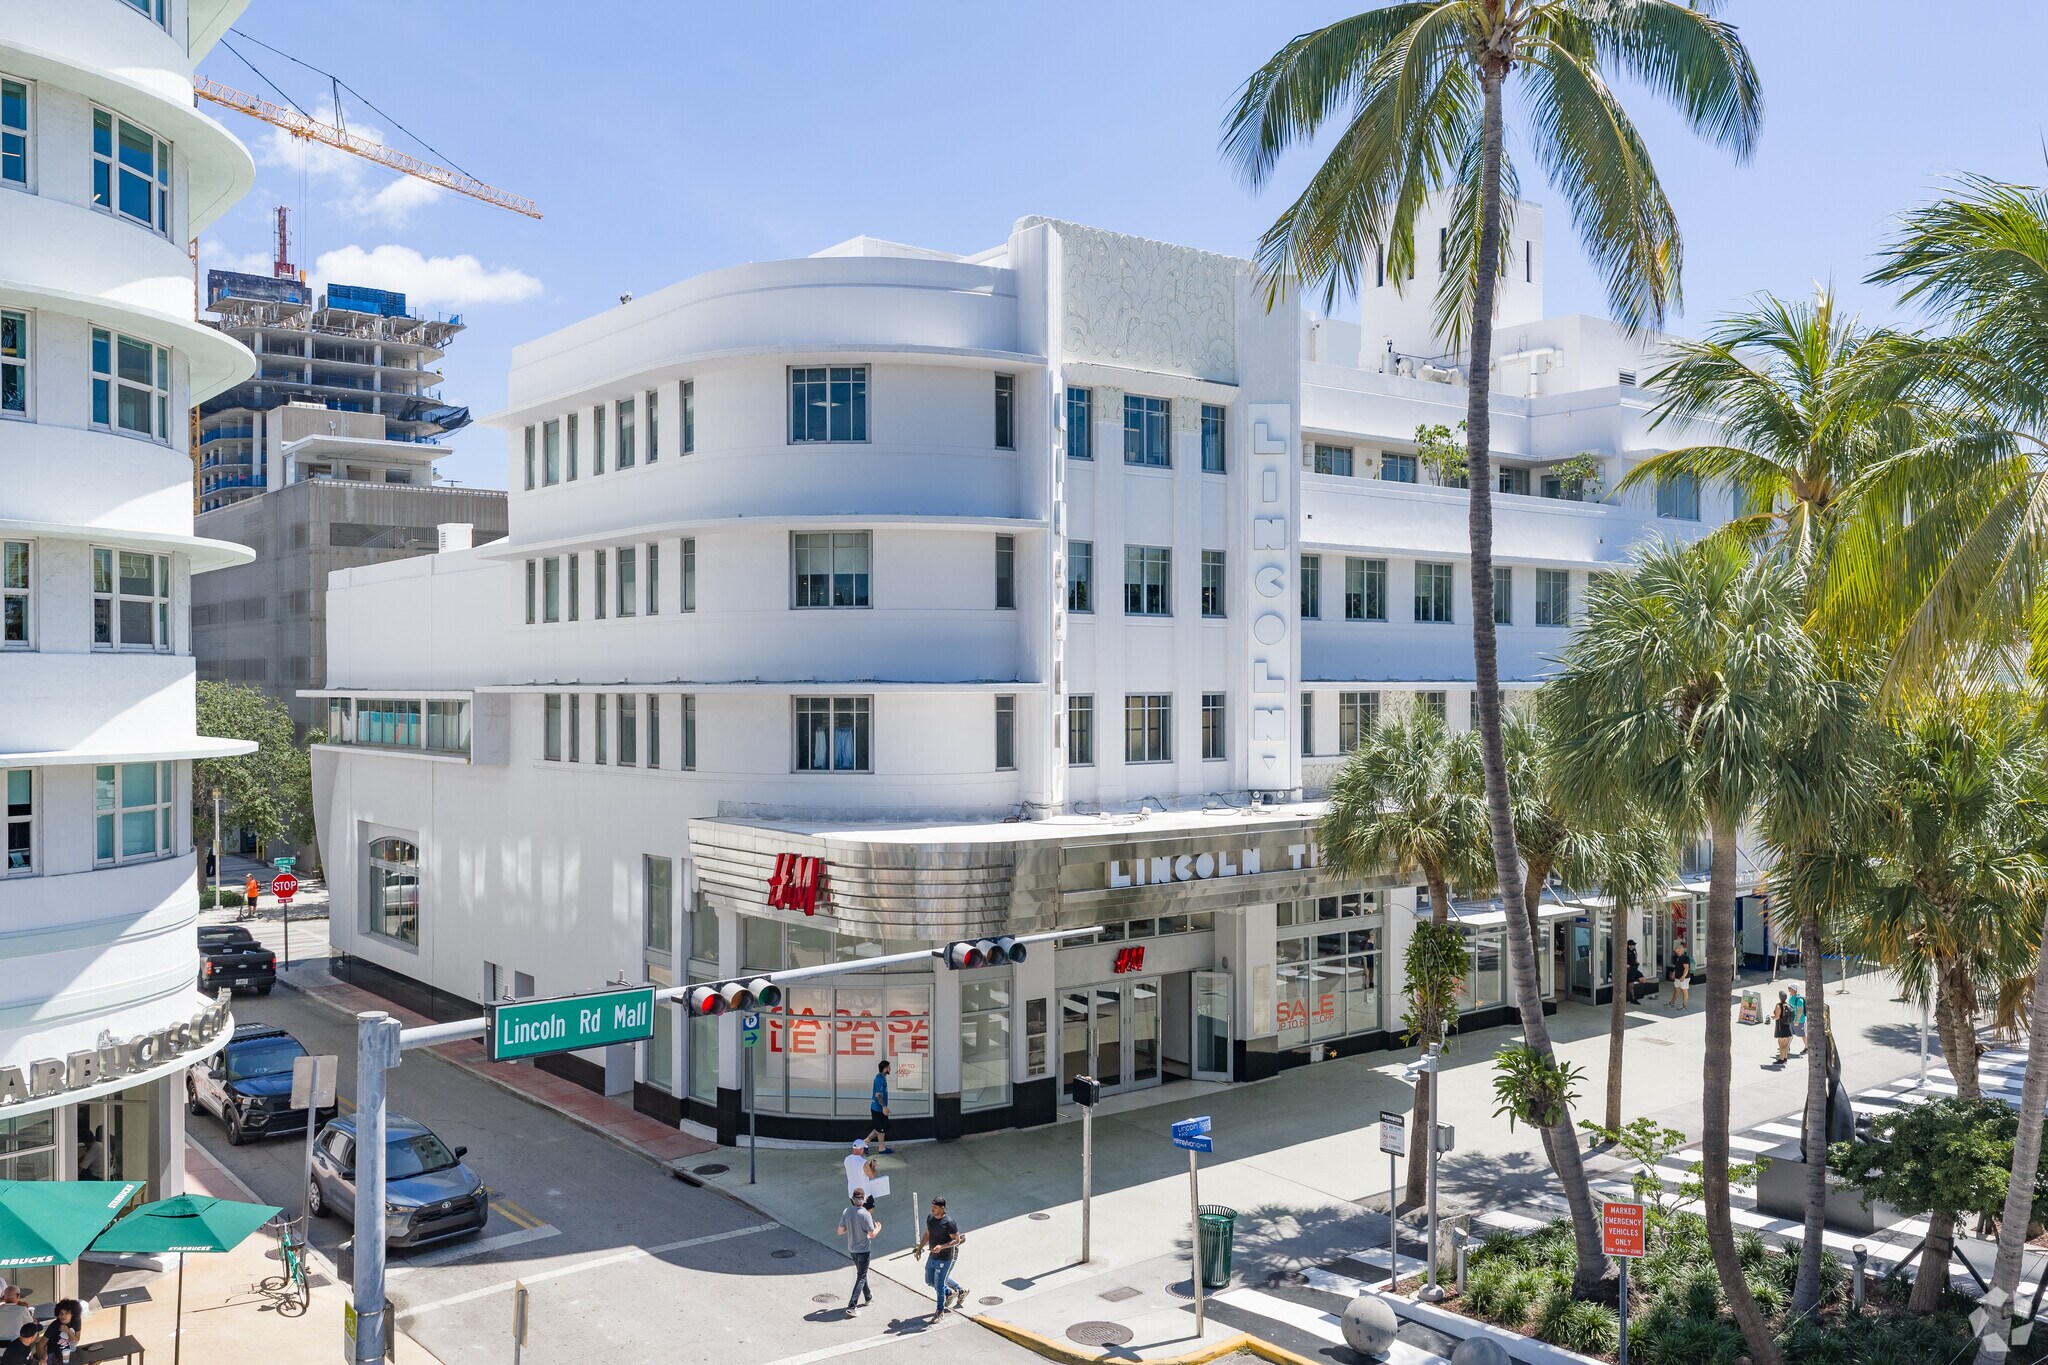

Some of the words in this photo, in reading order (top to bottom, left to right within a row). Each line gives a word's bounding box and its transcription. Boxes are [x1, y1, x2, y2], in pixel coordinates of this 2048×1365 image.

[1254, 422, 1286, 741] LINCOLN
[1108, 848, 1261, 888] LINCOLN
[273, 880, 297, 892] STOP
[1277, 994, 1334, 1023] SALE
[504, 1014, 565, 1045] Lincoln
[580, 1008, 600, 1034] Rd
[614, 1001, 646, 1029] Mall
[1610, 1207, 1636, 1215] MARKED
[1605, 1217, 1641, 1226] EMERGENCY
[1609, 1228, 1639, 1236] VEHICLES
[0, 1255, 54, 1266] RBUCKS
